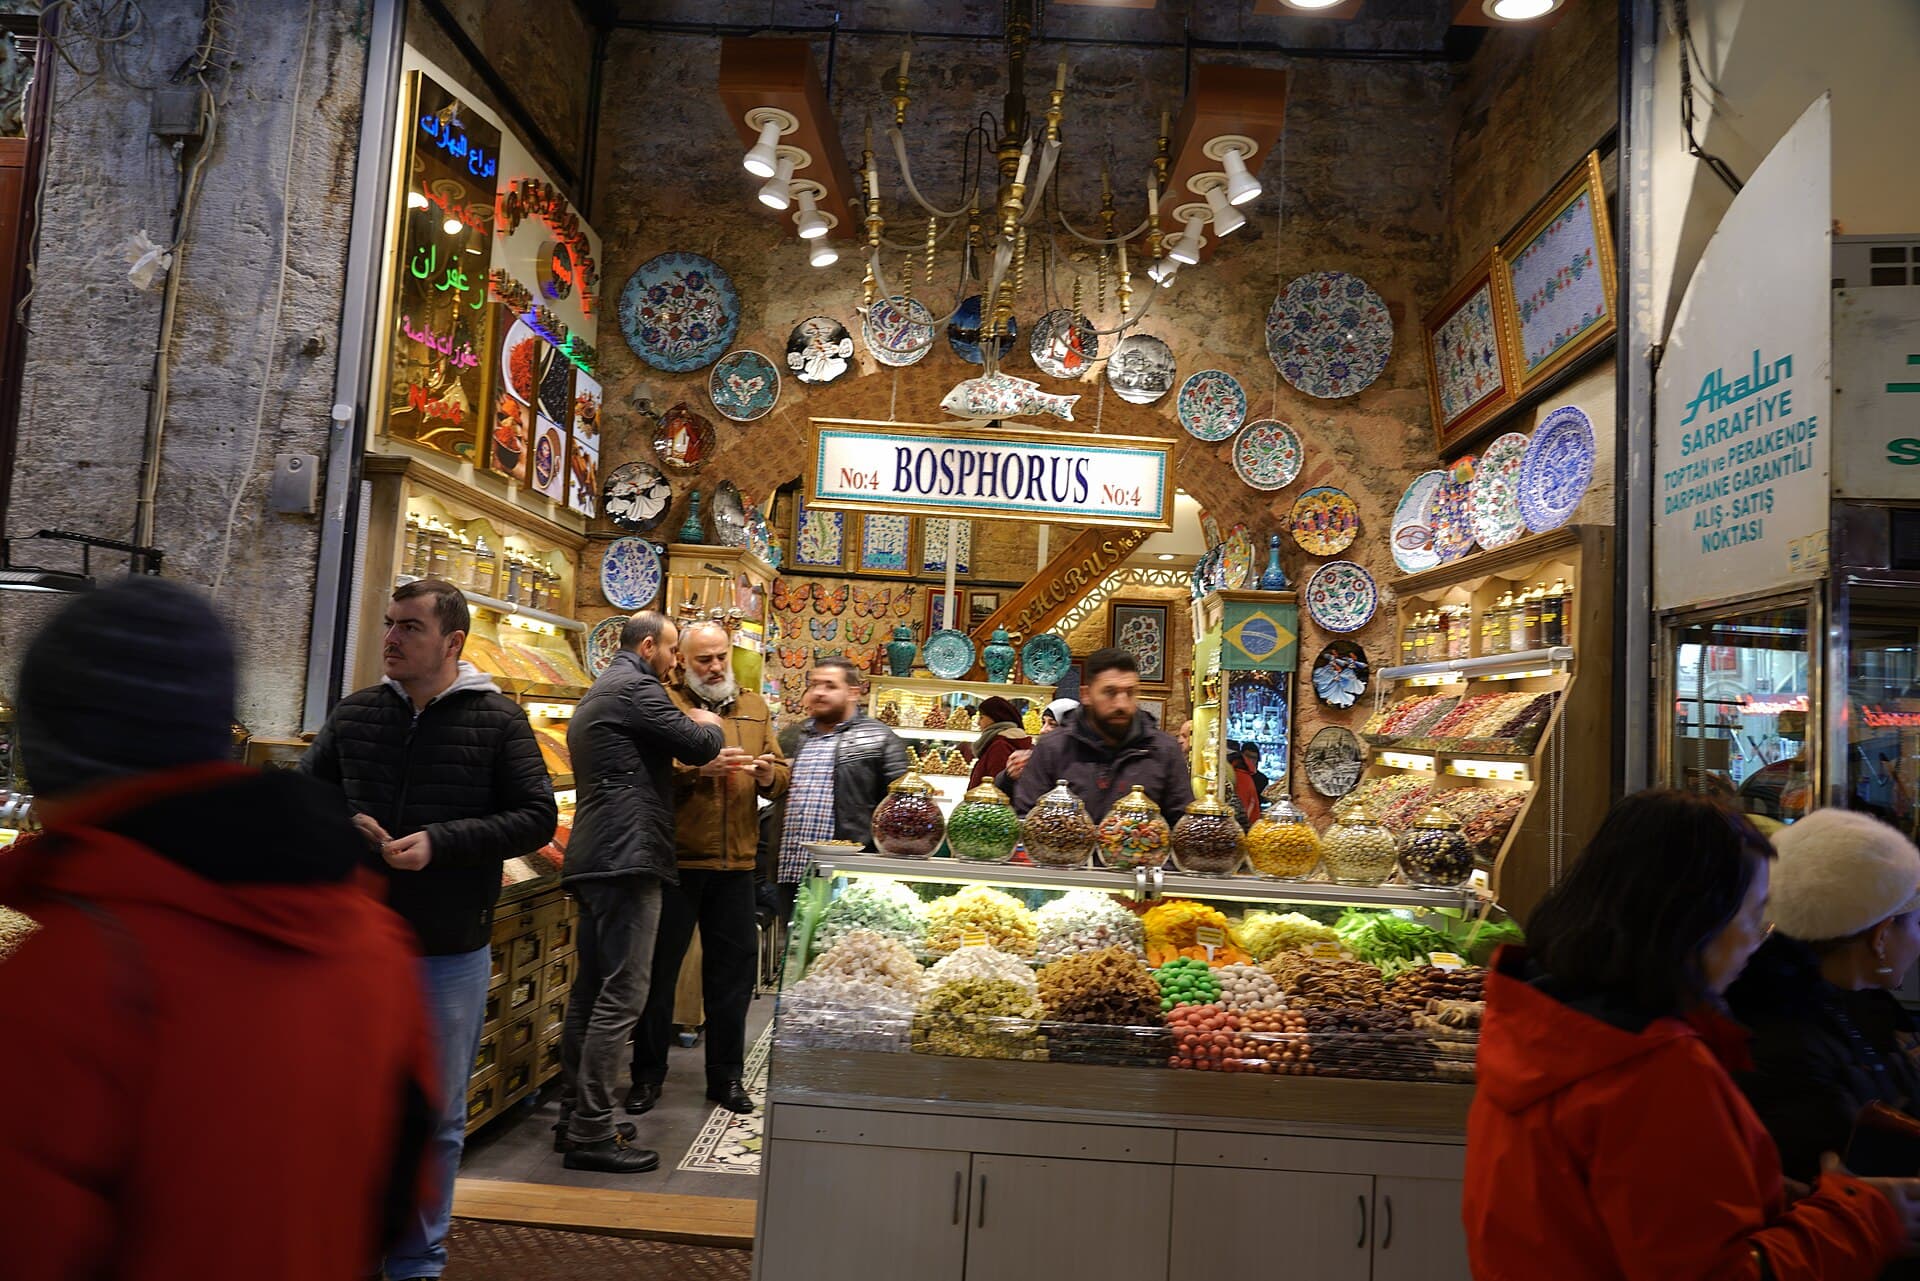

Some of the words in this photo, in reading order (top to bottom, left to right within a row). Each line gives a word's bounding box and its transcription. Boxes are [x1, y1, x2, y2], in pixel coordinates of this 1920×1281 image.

[1663, 457, 1710, 492] TOPTAN
[1711, 456, 1726, 473] ve
[1727, 415, 1818, 468] PERAKENDE
[1680, 389, 1793, 457] SARRAFİYE
[838, 466, 880, 491] No:4
[892, 446, 1090, 505] BOSPHORUS
[1100, 483, 1142, 507] No:4
[1664, 475, 1730, 516] DARPHANE
[1732, 441, 1813, 493] GARANTİLİ
[1692, 503, 1723, 531] ALIŞ
[1731, 488, 1775, 519] SATIŞ
[1701, 518, 1764, 554] NOKTASI
